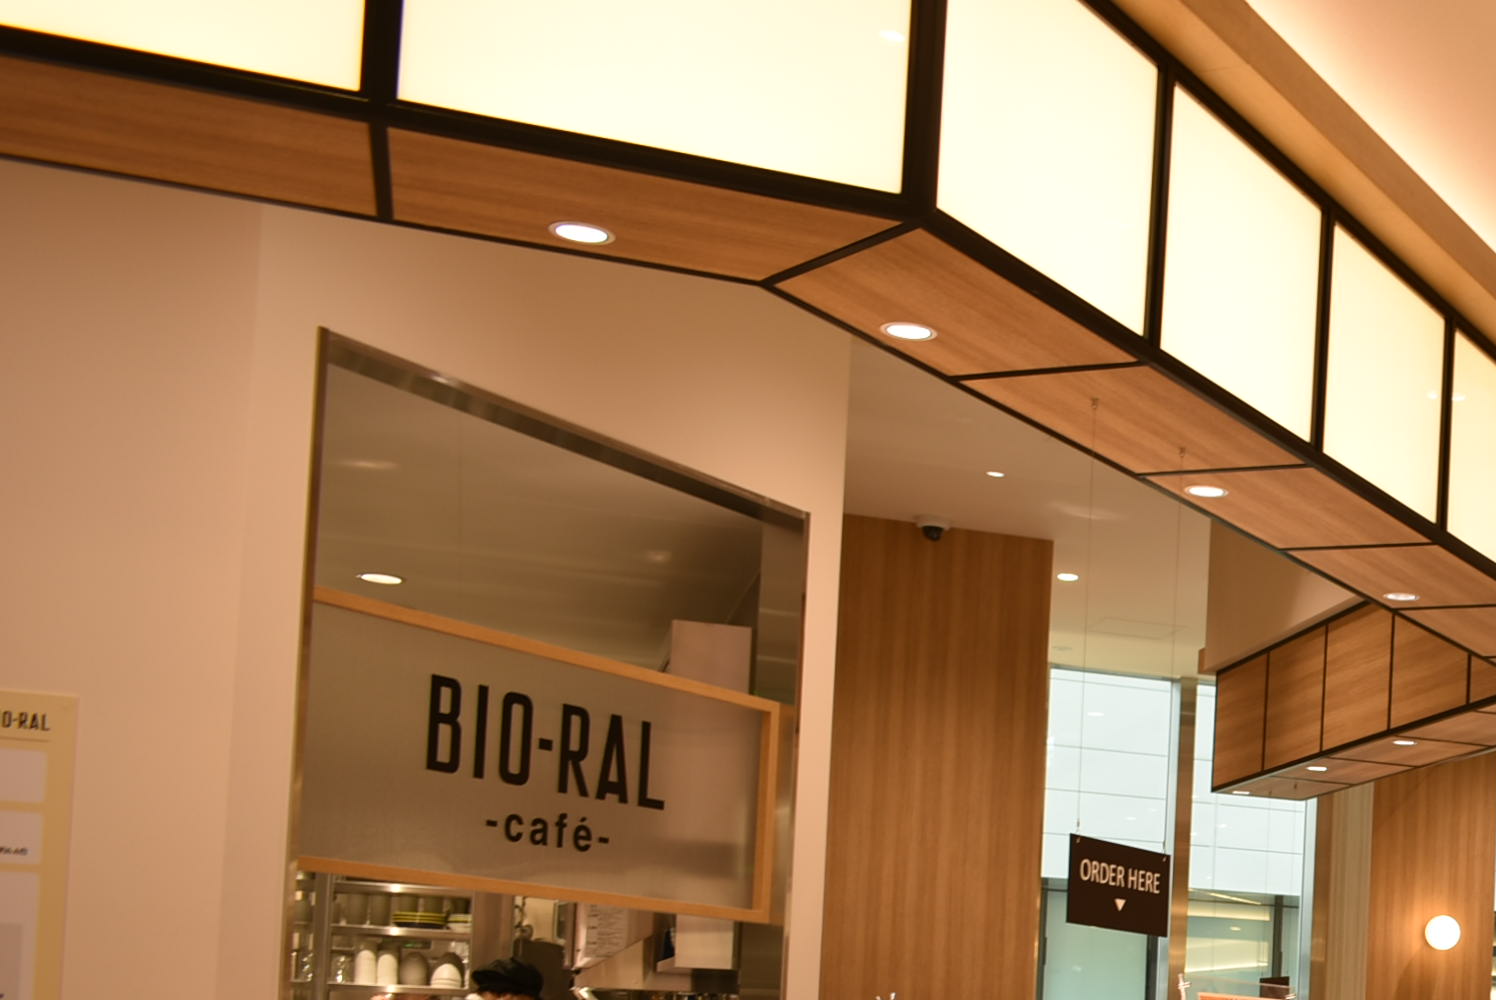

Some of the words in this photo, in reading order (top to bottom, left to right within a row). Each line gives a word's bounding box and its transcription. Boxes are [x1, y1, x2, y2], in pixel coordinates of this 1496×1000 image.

[1, 710, 52, 732] O-RAL
[426, 674, 665, 811] BIO-RAL
[485, 813, 610, 852] -café-
[1080, 858, 1125, 888] ORDER
[1127, 868, 1161, 894] HERE
